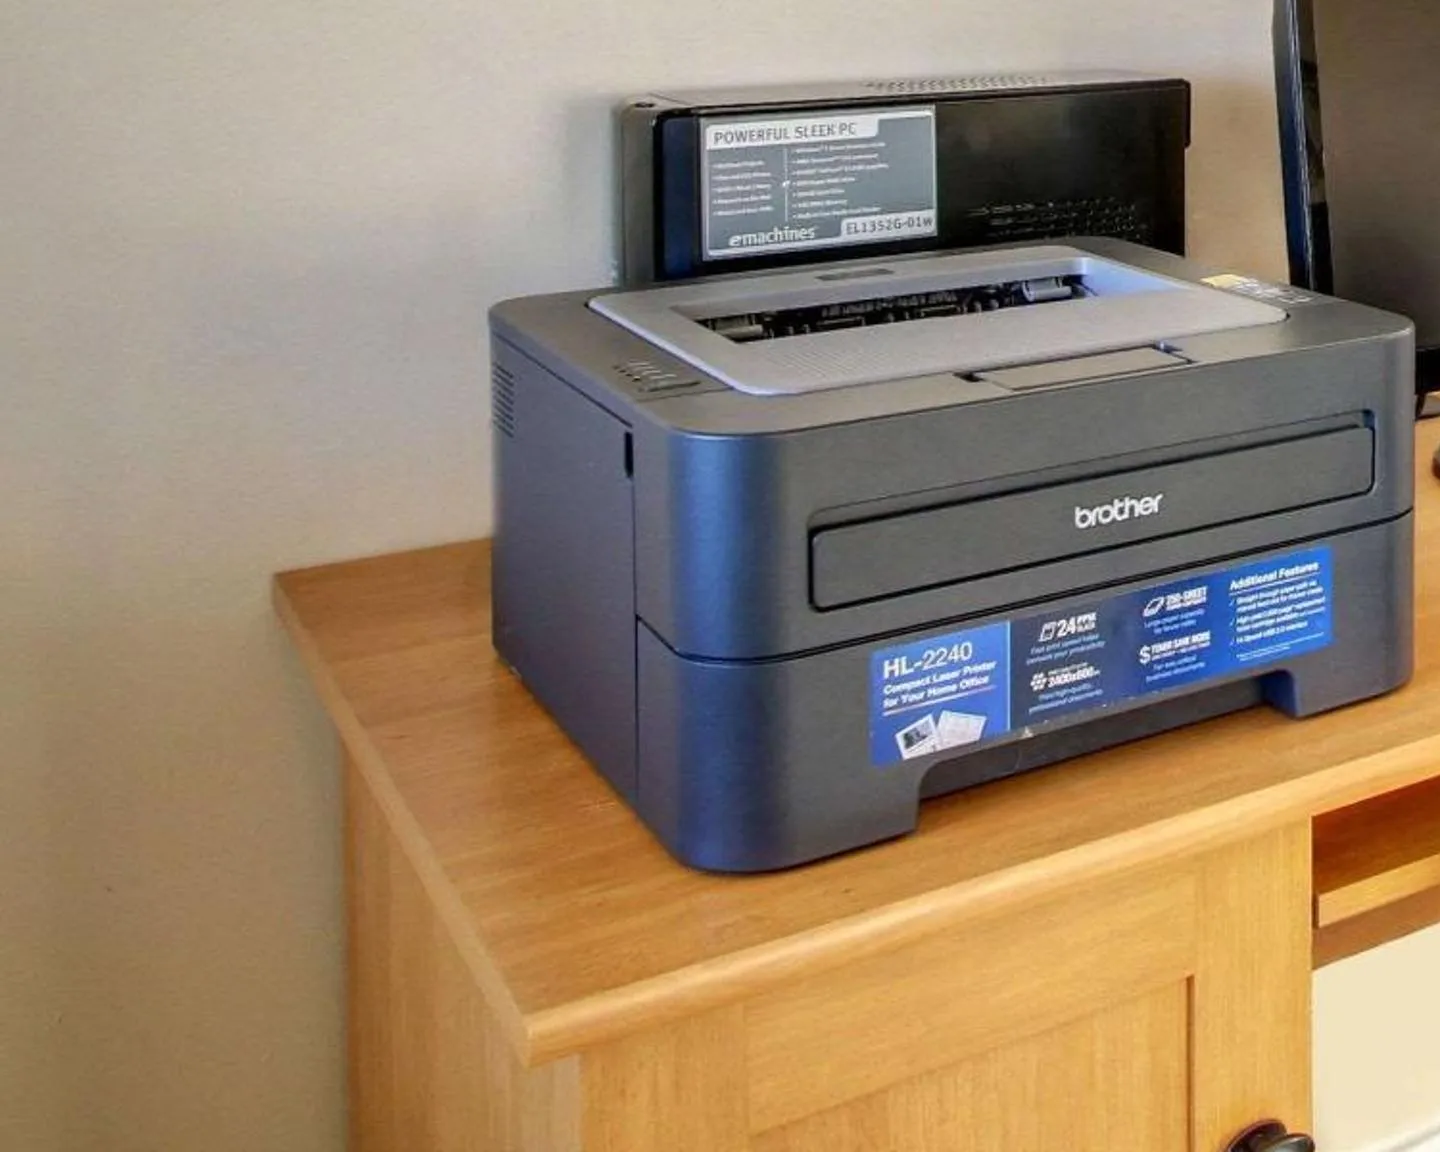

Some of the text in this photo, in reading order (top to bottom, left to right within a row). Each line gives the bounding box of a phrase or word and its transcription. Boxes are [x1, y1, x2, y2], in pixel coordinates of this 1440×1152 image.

[713, 122, 858, 145] POWERFUL SLEEK PC
[728, 225, 818, 247] emachines
[1074, 493, 1164, 529] brother
[1230, 561, 1319, 590] Additional Features
[1057, 616, 1076, 638] 24
[883, 641, 973, 680] HL-2240
[883, 661, 998, 696] Compact Laser Printer
[883, 676, 990, 709] for Your Home Office
